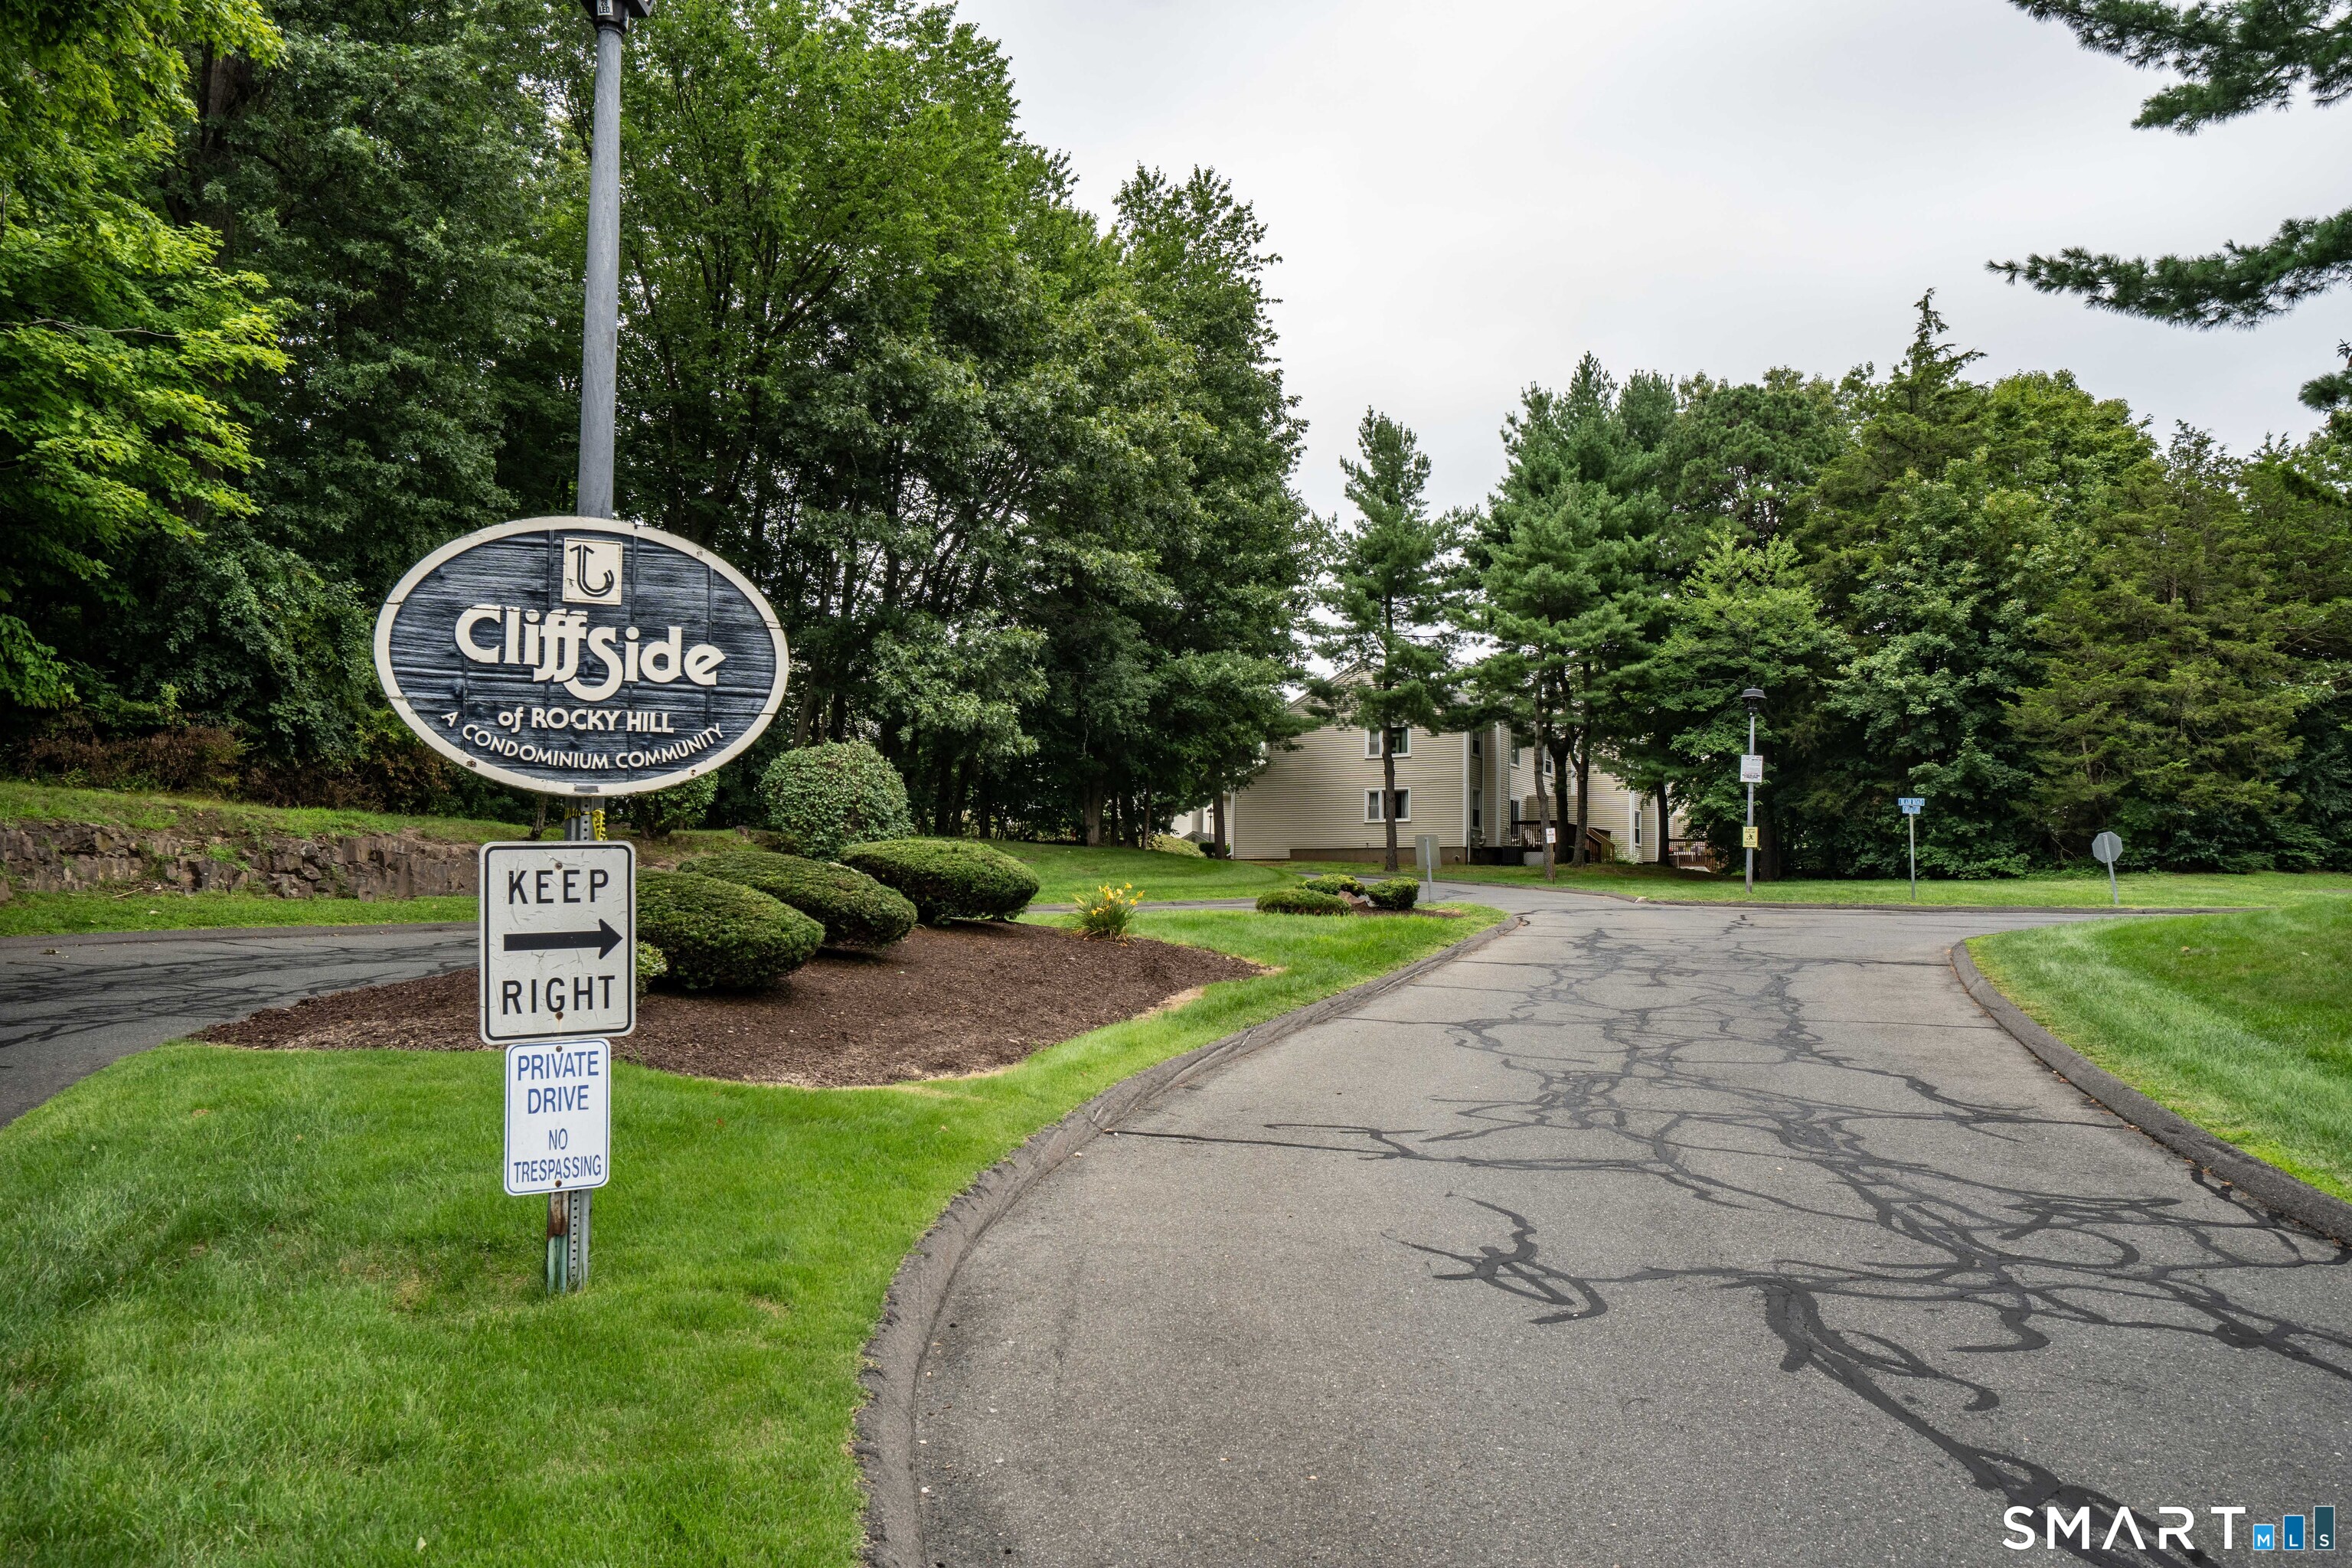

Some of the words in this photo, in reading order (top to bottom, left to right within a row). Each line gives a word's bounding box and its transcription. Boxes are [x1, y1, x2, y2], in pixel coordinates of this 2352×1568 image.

[498, 707, 524, 733] of
[531, 707, 622, 733] ROCKY
[626, 711, 675, 733] HILL
[441, 711, 458, 728] A
[462, 724, 609, 769] CONDOMINIUM
[616, 723, 724, 769] COMMUNITY
[508, 869, 609, 905] KEEP
[501, 975, 616, 1015] RIGHT
[518, 1050, 599, 1081] PRIVATE
[528, 1084, 590, 1115] DRIVE
[548, 1129, 568, 1151] NO
[514, 1155, 602, 1184] TRESPASSING
